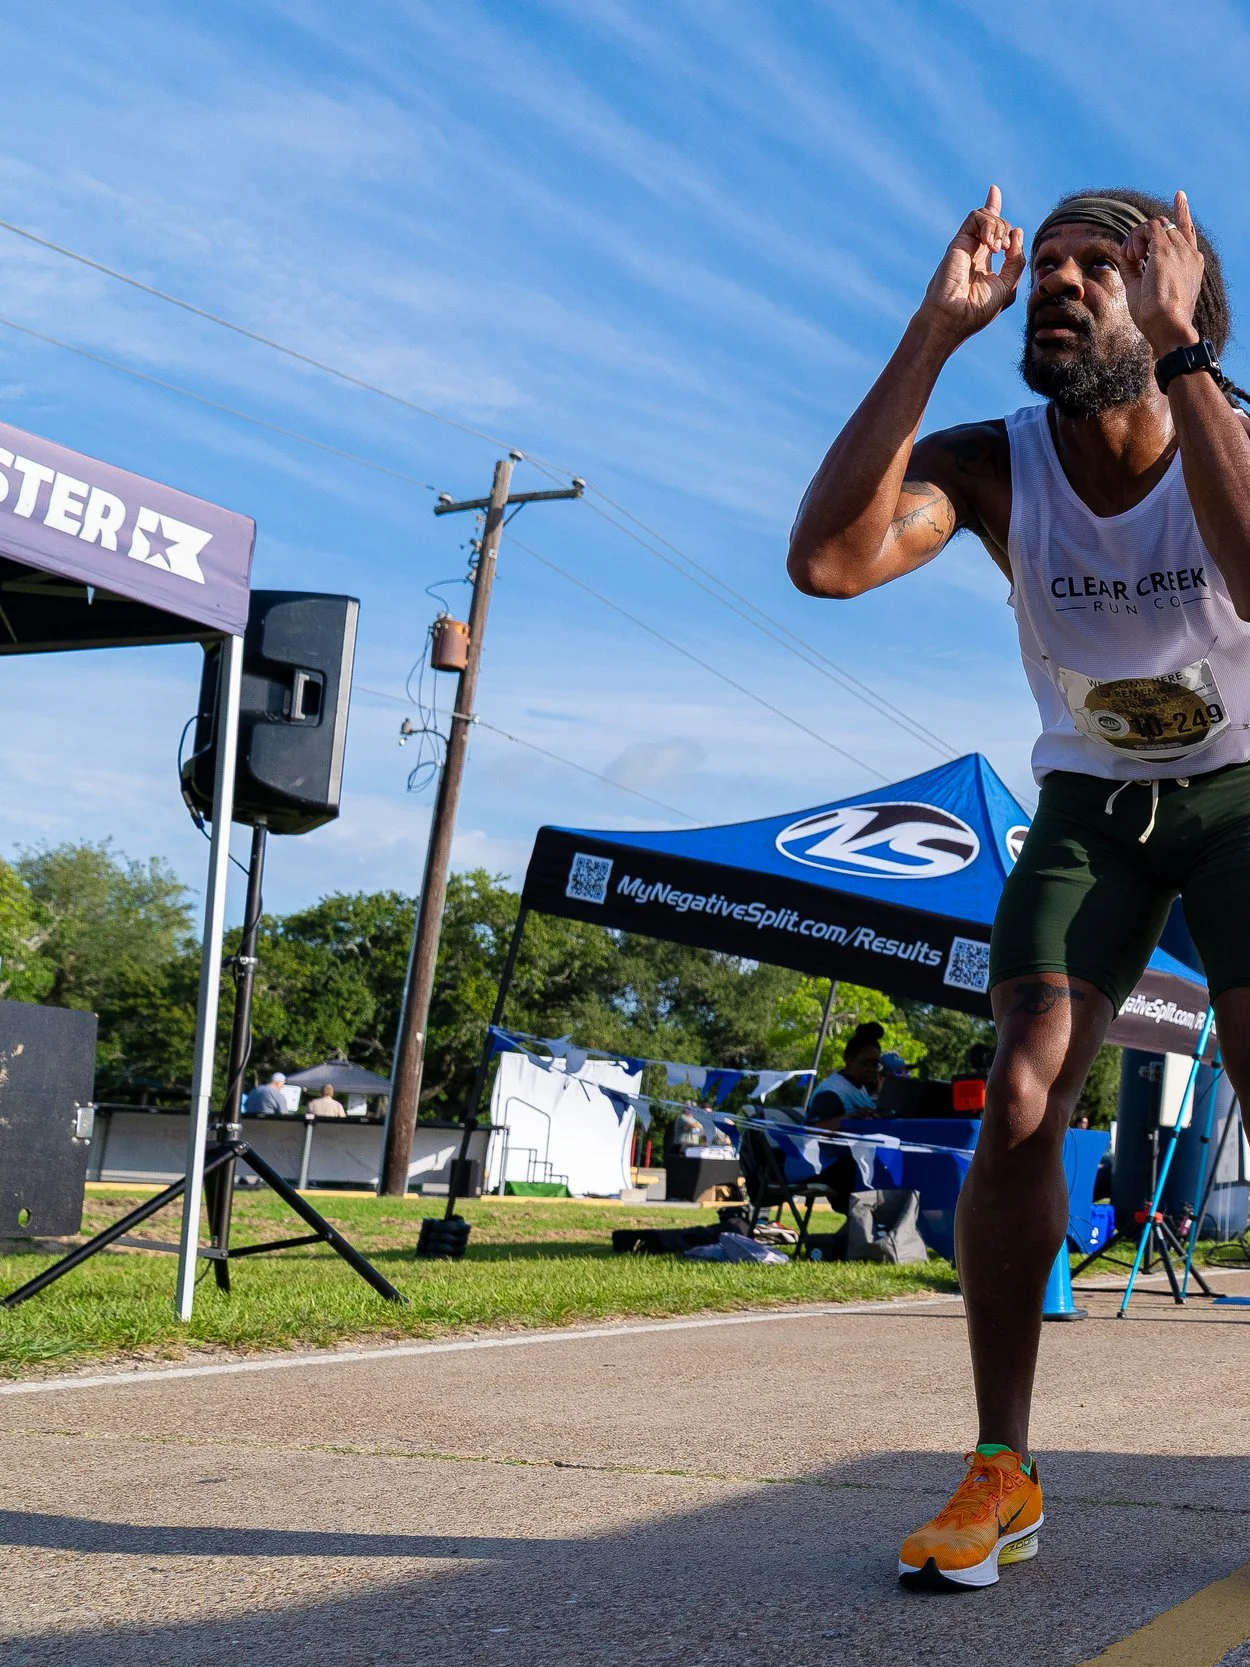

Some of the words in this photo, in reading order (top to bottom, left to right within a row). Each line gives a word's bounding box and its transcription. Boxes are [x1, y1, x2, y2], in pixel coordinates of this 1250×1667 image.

[1051, 576, 1130, 600] CLEAR
[1136, 567, 1208, 597] CREEK
[1094, 601, 1139, 615] RUN
[1154, 596, 1181, 609] CO
[1151, 671, 1183, 686] HERE
[1114, 683, 1182, 698] REMEMBER
[616, 873, 943, 967] MyNegativeSplit.com/Results
